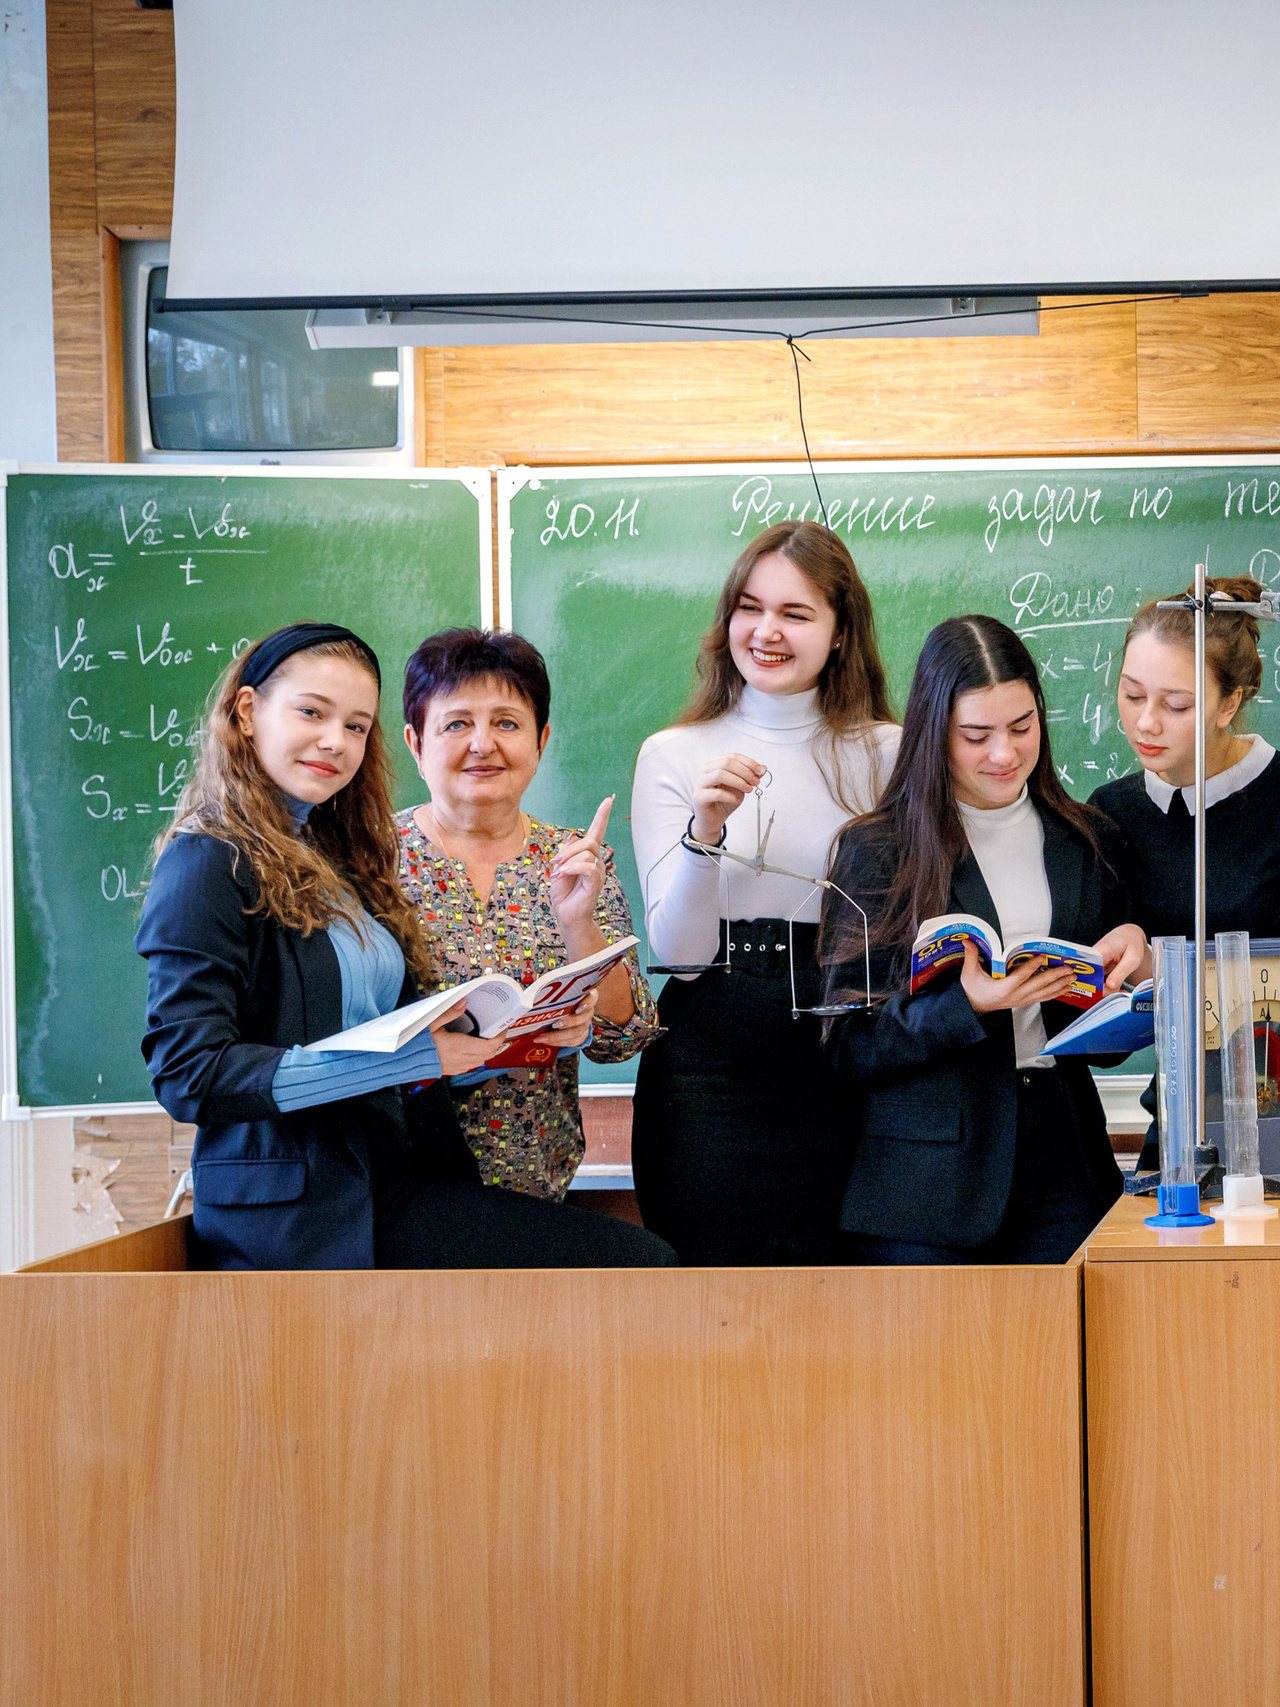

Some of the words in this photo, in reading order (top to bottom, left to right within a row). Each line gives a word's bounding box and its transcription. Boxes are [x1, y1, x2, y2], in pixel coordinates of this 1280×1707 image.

[984, 483, 1105, 553] задач
[1129, 486, 1174, 521] по
[918, 932, 970, 958] ОГЭ
[509, 1008, 565, 1028] ИЗИКА
